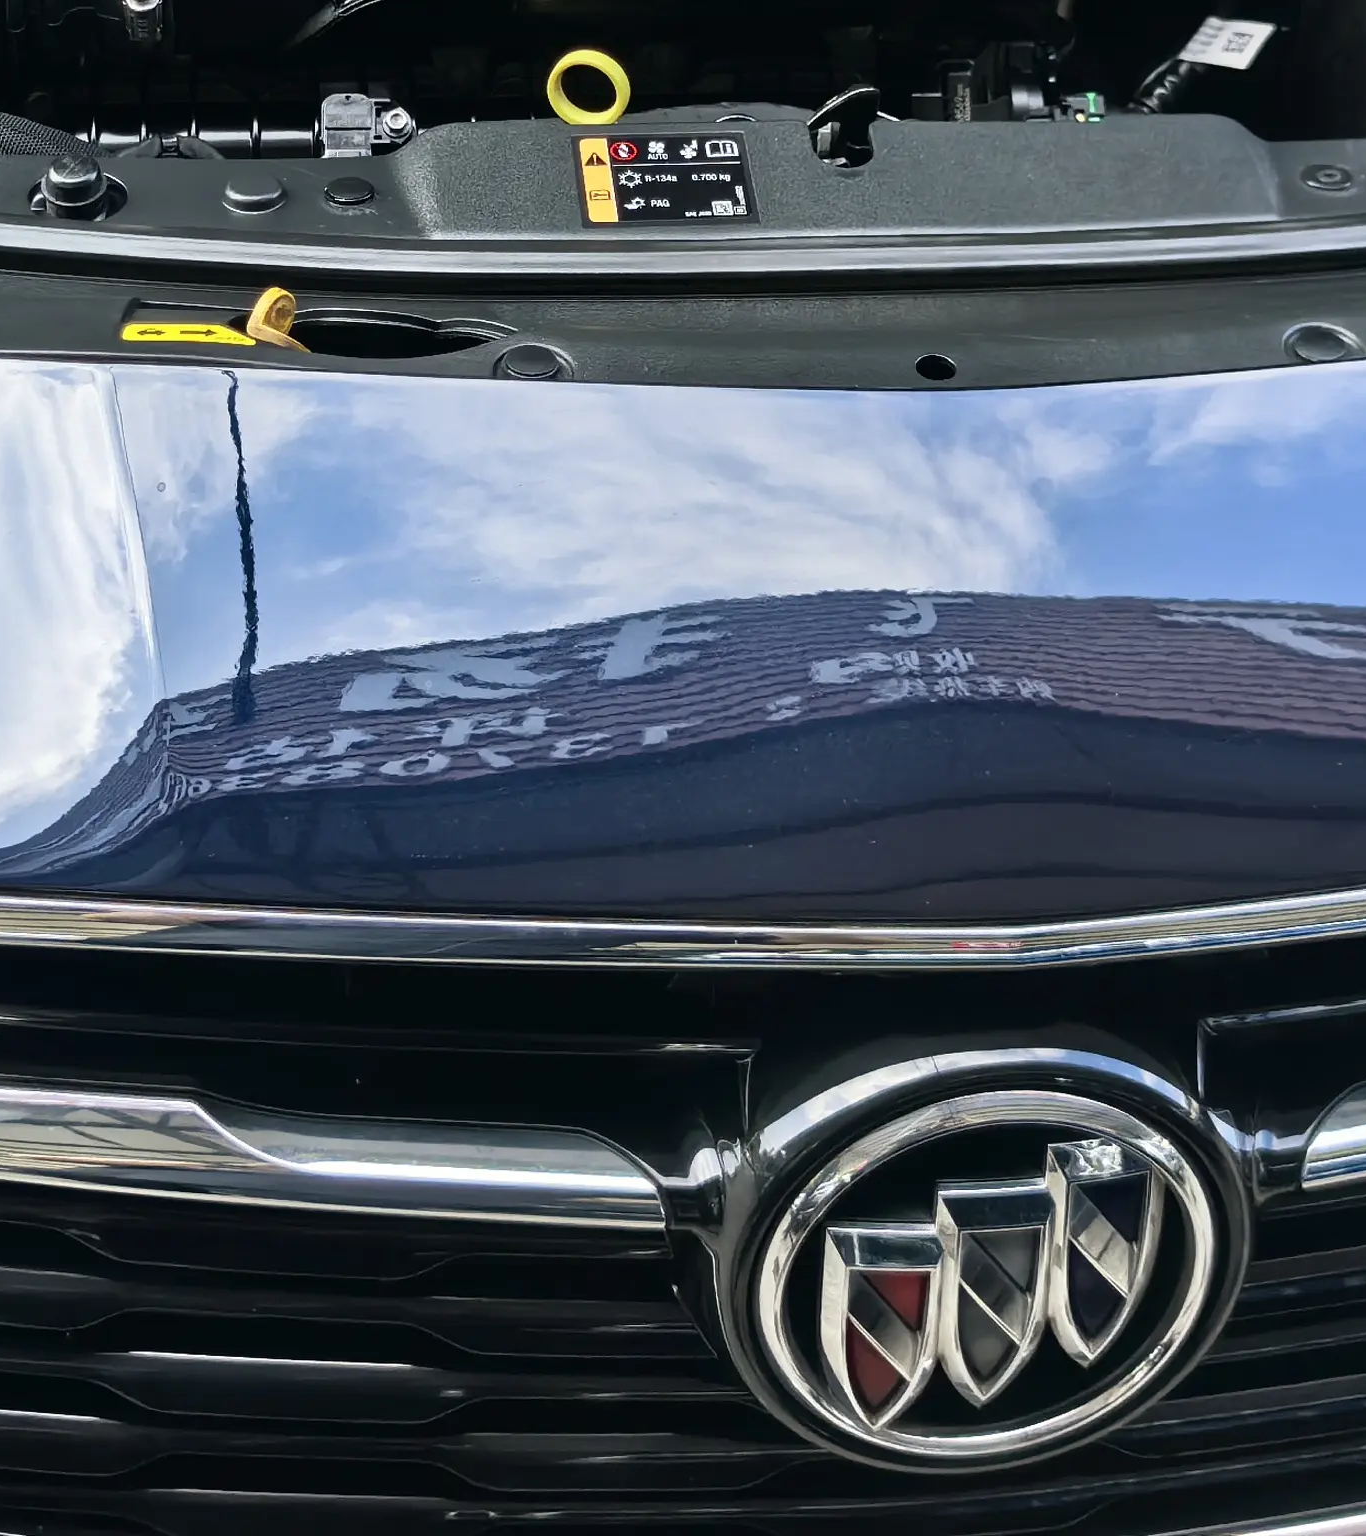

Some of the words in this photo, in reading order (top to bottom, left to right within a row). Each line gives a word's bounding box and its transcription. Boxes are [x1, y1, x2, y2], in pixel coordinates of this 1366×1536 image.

[647, 153, 669, 161] AUTO
[644, 173, 678, 183] R-134a
[691, 173, 717, 182] 0.700
[718, 173, 731, 183] kg
[650, 199, 671, 208] PAG
